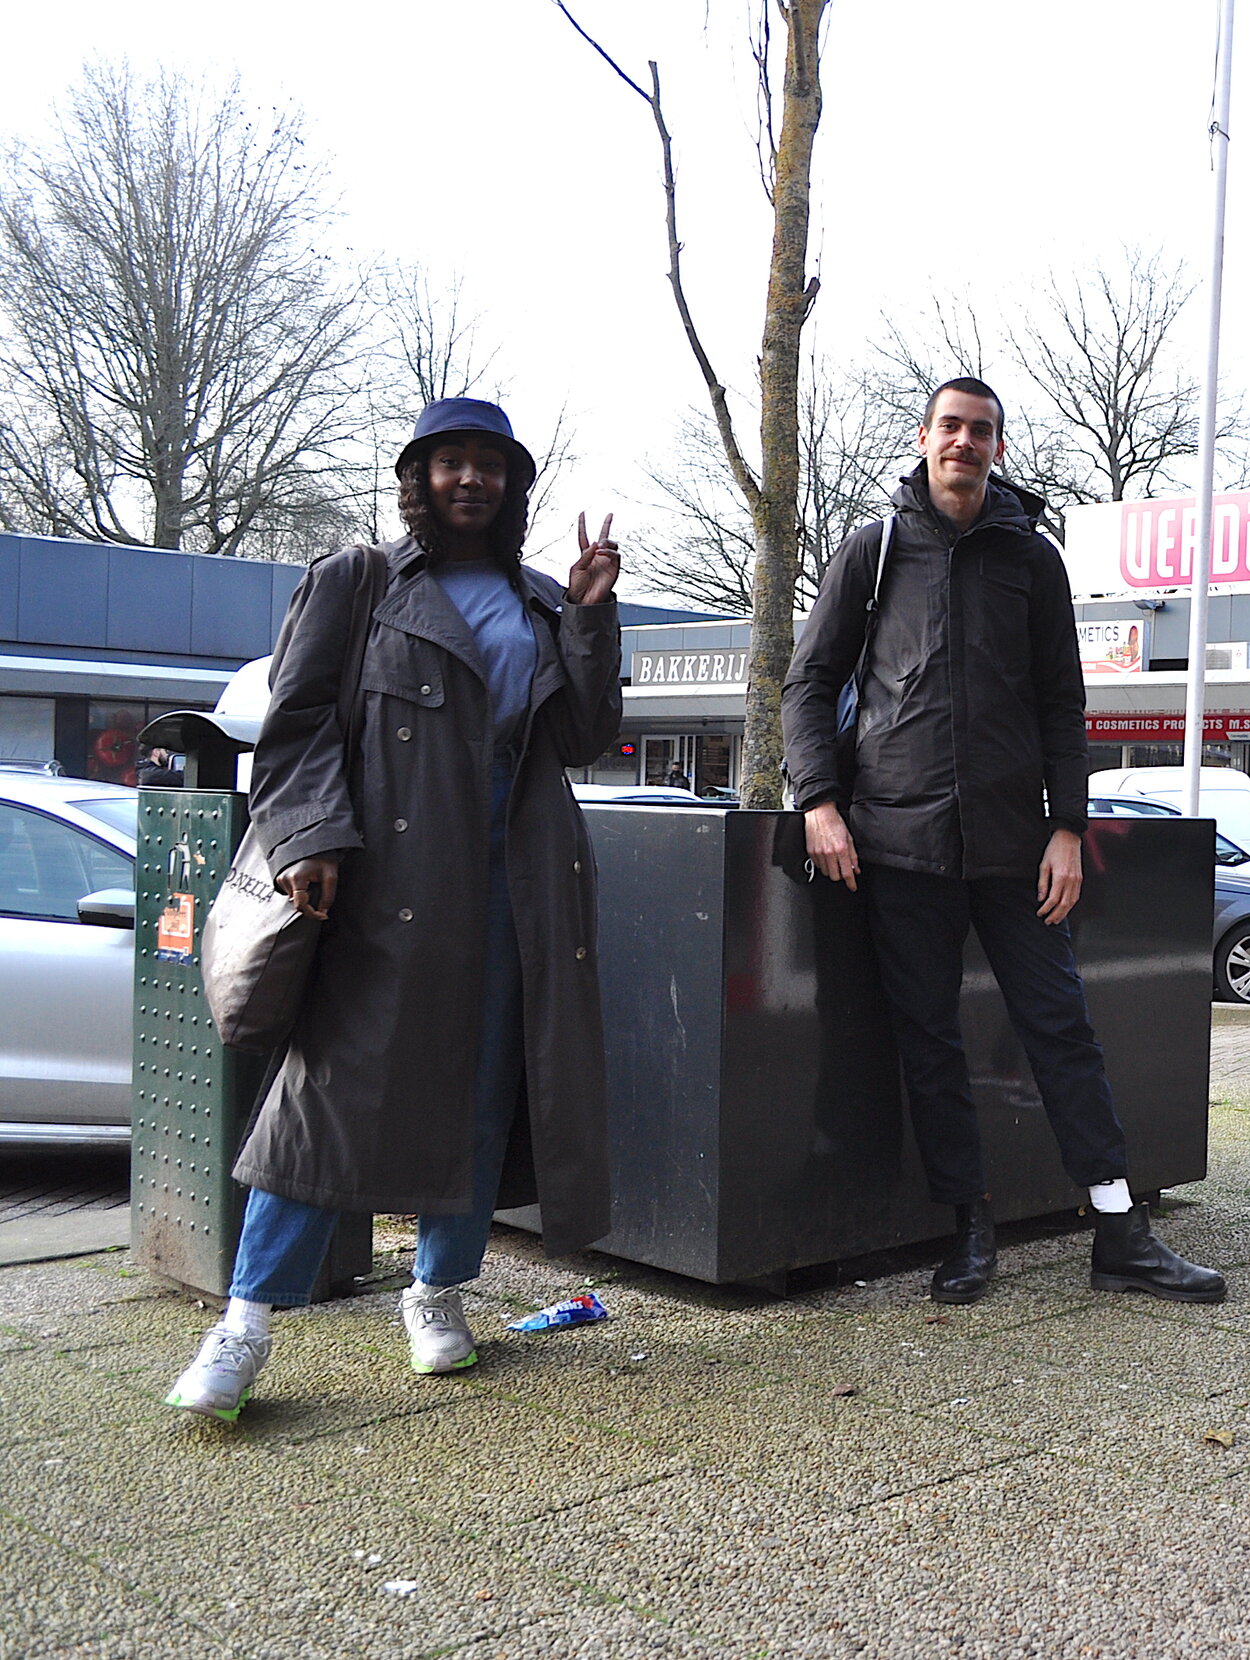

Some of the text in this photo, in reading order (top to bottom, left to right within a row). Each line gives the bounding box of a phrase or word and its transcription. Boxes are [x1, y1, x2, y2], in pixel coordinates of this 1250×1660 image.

[1078, 626, 1119, 641] METICS
[638, 653, 747, 683] BAKKERIJ
[1096, 719, 1160, 731] COSMETICS
[1163, 719, 1223, 731] PROCTS
